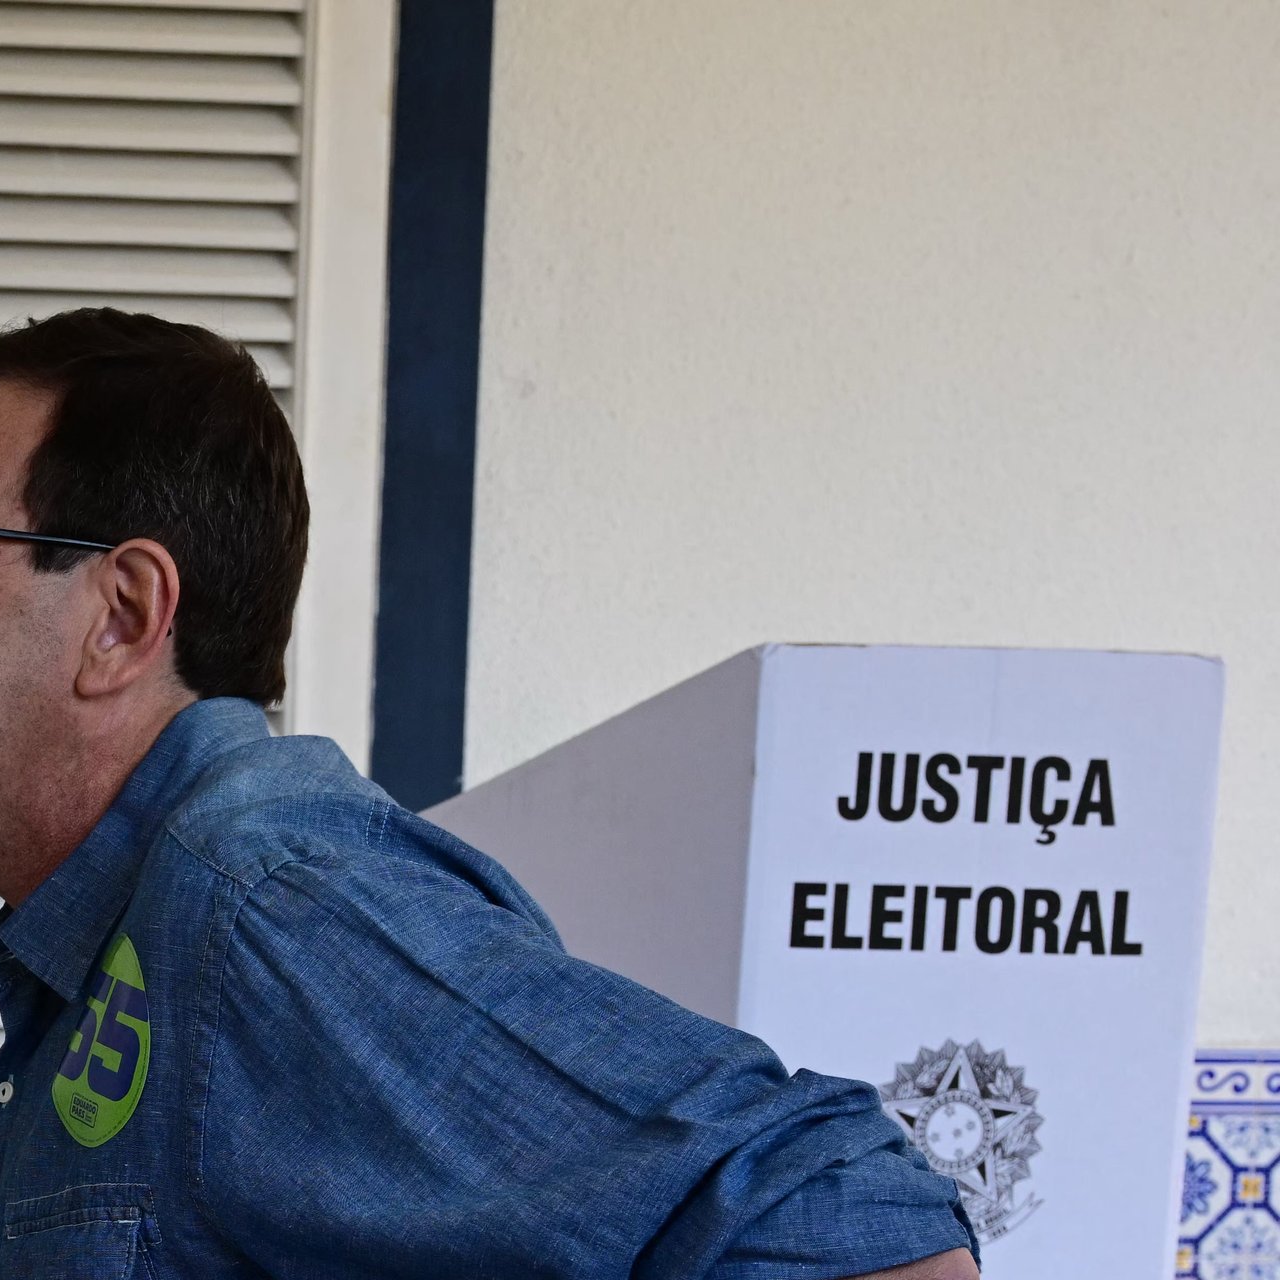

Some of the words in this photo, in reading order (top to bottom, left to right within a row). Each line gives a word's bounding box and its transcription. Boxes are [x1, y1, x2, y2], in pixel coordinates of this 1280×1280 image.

[836, 751, 1116, 845] JUSTIÇA
[788, 881, 1144, 956] ELEITORAL
[71, 1104, 86, 1119] PAES
